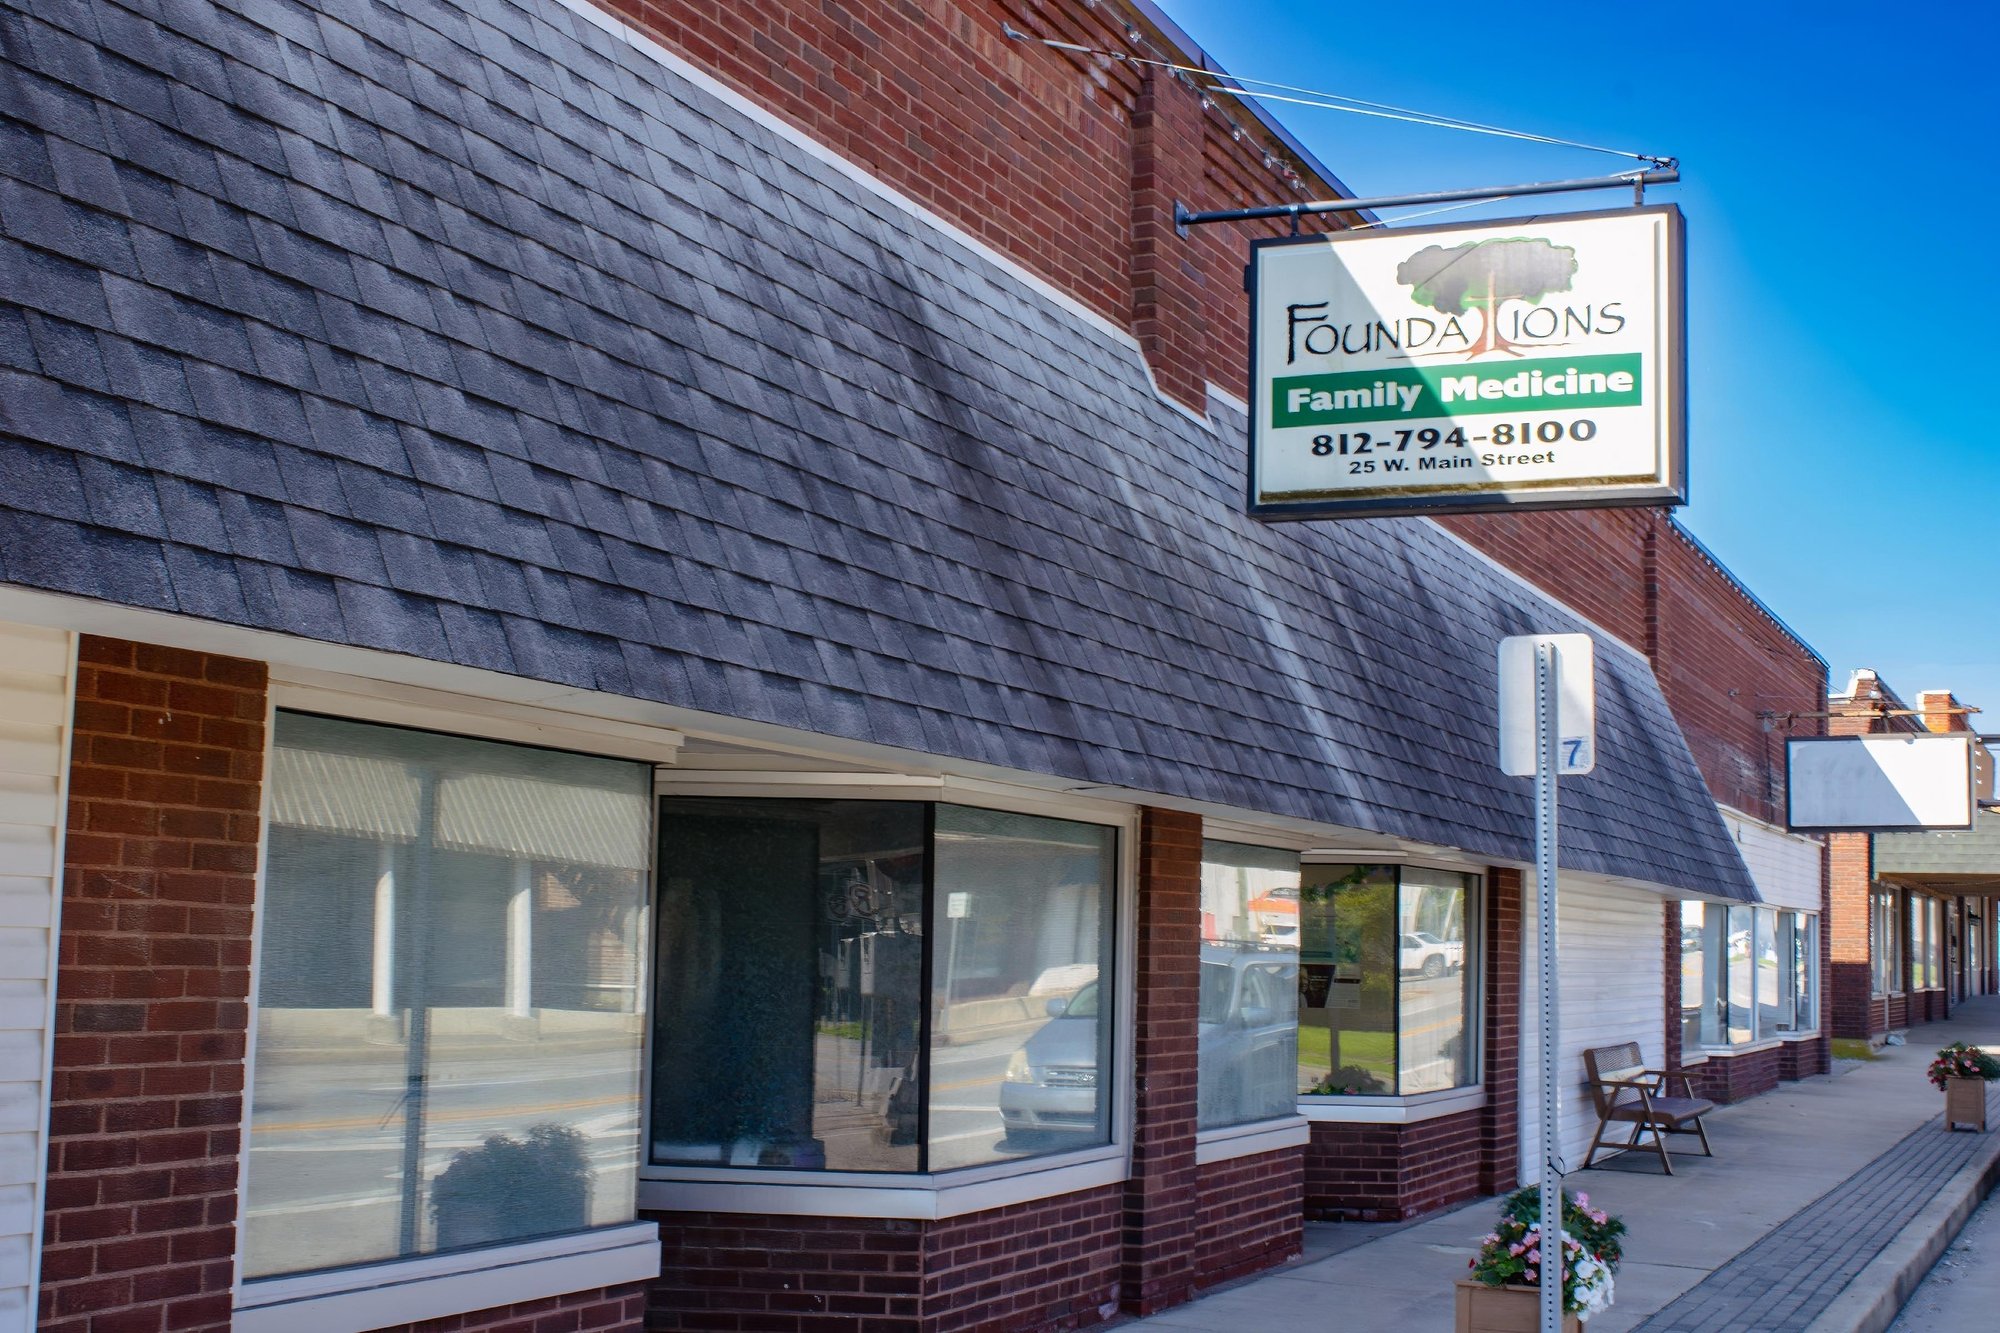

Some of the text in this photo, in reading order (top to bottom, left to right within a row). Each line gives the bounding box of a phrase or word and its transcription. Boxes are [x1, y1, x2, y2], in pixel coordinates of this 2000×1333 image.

[1287, 367, 1634, 413] Family Medicine
[1311, 419, 1597, 457] 812-794-8100
[1349, 450, 1556, 475] 25 W. Main Street
[1562, 740, 1582, 766] 7
